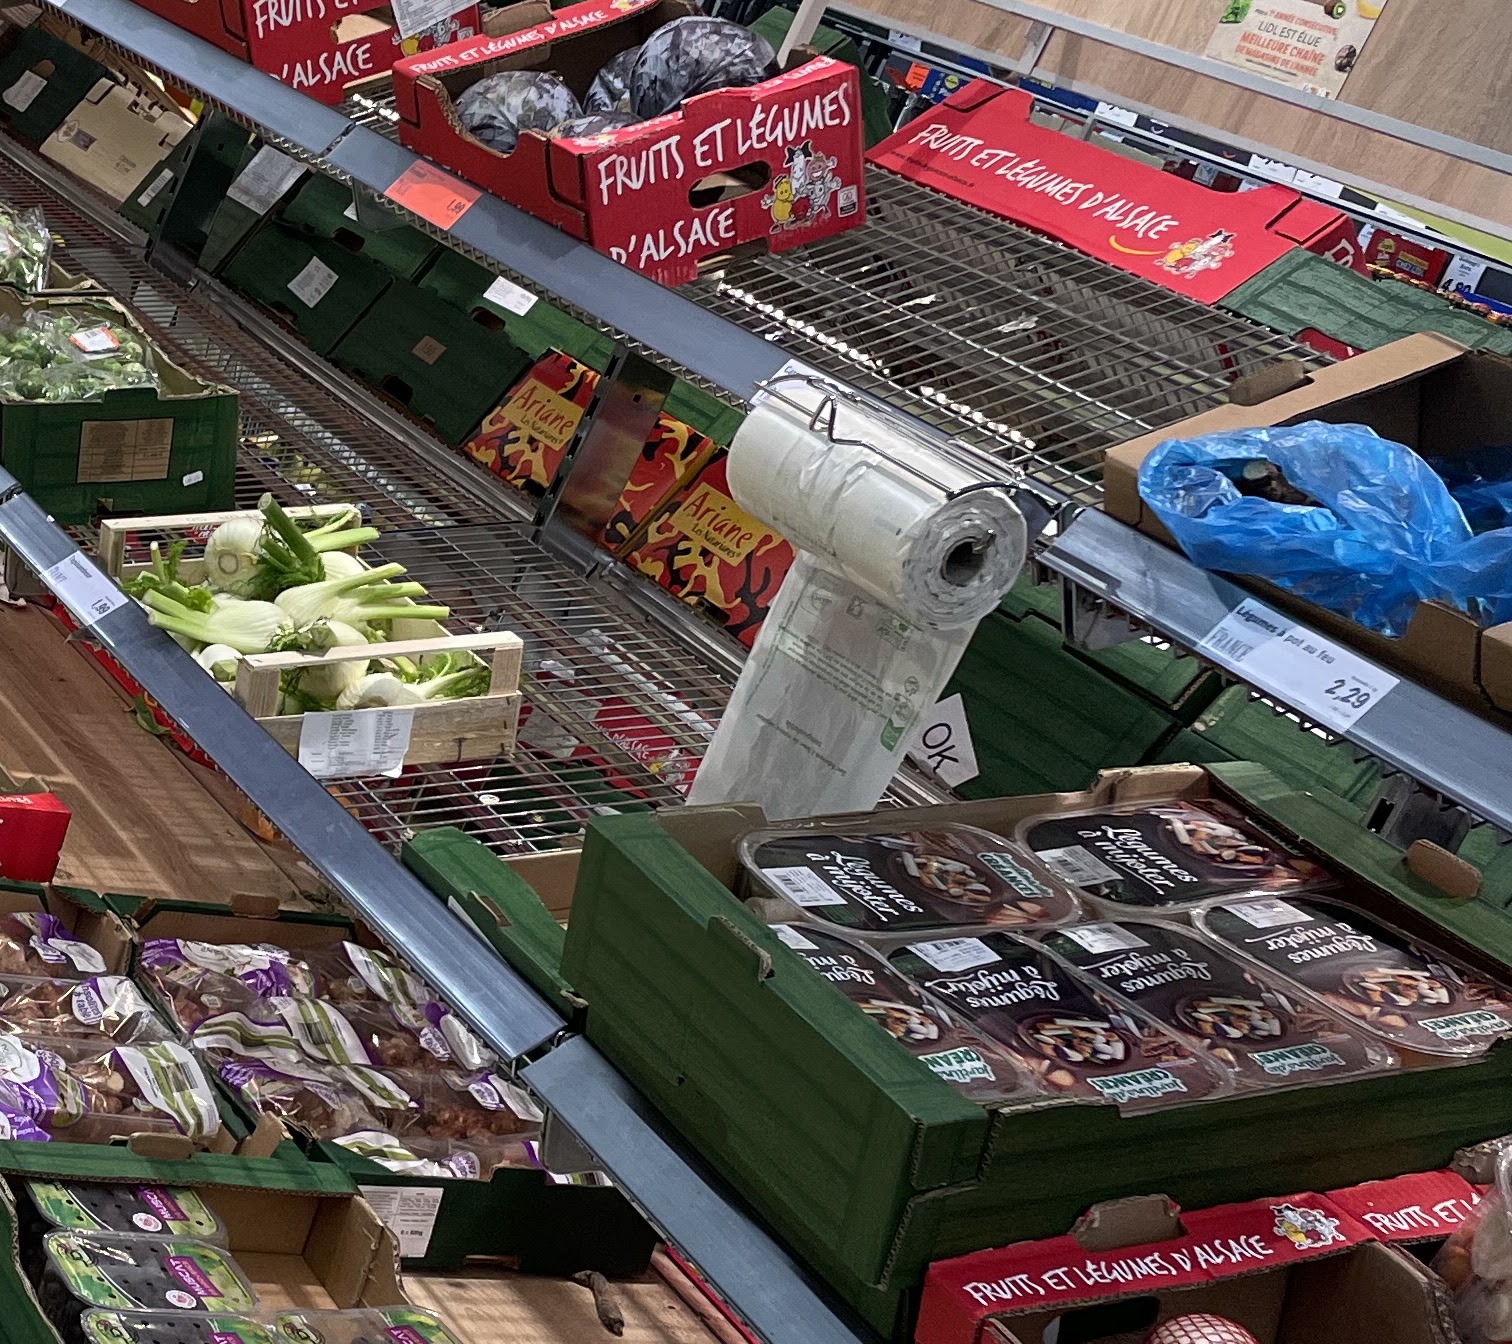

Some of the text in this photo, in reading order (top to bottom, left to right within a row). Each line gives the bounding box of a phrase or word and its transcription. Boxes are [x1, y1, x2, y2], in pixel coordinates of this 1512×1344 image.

[409, 9, 609, 75] FRUITS ET LÉGUMES D'ALSACE
[1240, 30, 1292, 57] MEILLEURE
[1257, 19, 1323, 48] LIDL EST ÉLUE
[598, 82, 853, 206] FRUITS ET LÉGUMES
[912, 122, 984, 162] FRUITS
[974, 146, 1007, 171] ET
[997, 155, 1090, 209] LÉGUMES
[1081, 189, 1180, 241] D'ALSACE
[608, 207, 737, 268] D'ALSACE
[513, 385, 576, 437] Ariane
[683, 491, 753, 550] Ariane
[1207, 628, 1255, 663] FRANCE
[1236, 606, 1279, 635] Légumes
[1283, 633, 1306, 651] pot
[1302, 644, 1318, 655] au
[1316, 650, 1336, 665] feu
[1324, 677, 1372, 709] 2,29
[922, 721, 959, 775] OK
[1077, 829, 1097, 840] à
[1094, 840, 1176, 889] mijoter
[1101, 824, 1199, 884] Légumes
[823, 864, 900, 917] mijoter
[830, 850, 925, 914] Légumes
[1266, 924, 1334, 952] mijoter
[1287, 933, 1378, 966] Légumes
[945, 968, 1019, 996] mijoter
[1100, 951, 1173, 980] mijoter
[1120, 960, 1213, 994] Légumes
[967, 977, 1062, 1009] Légumes
[1362, 1198, 1461, 1234] FRUITS ET
[170, 1257, 208, 1297] MUSCAT
[963, 1234, 1274, 1307] FRUITS ET LÉGUMES D'ALSACE
